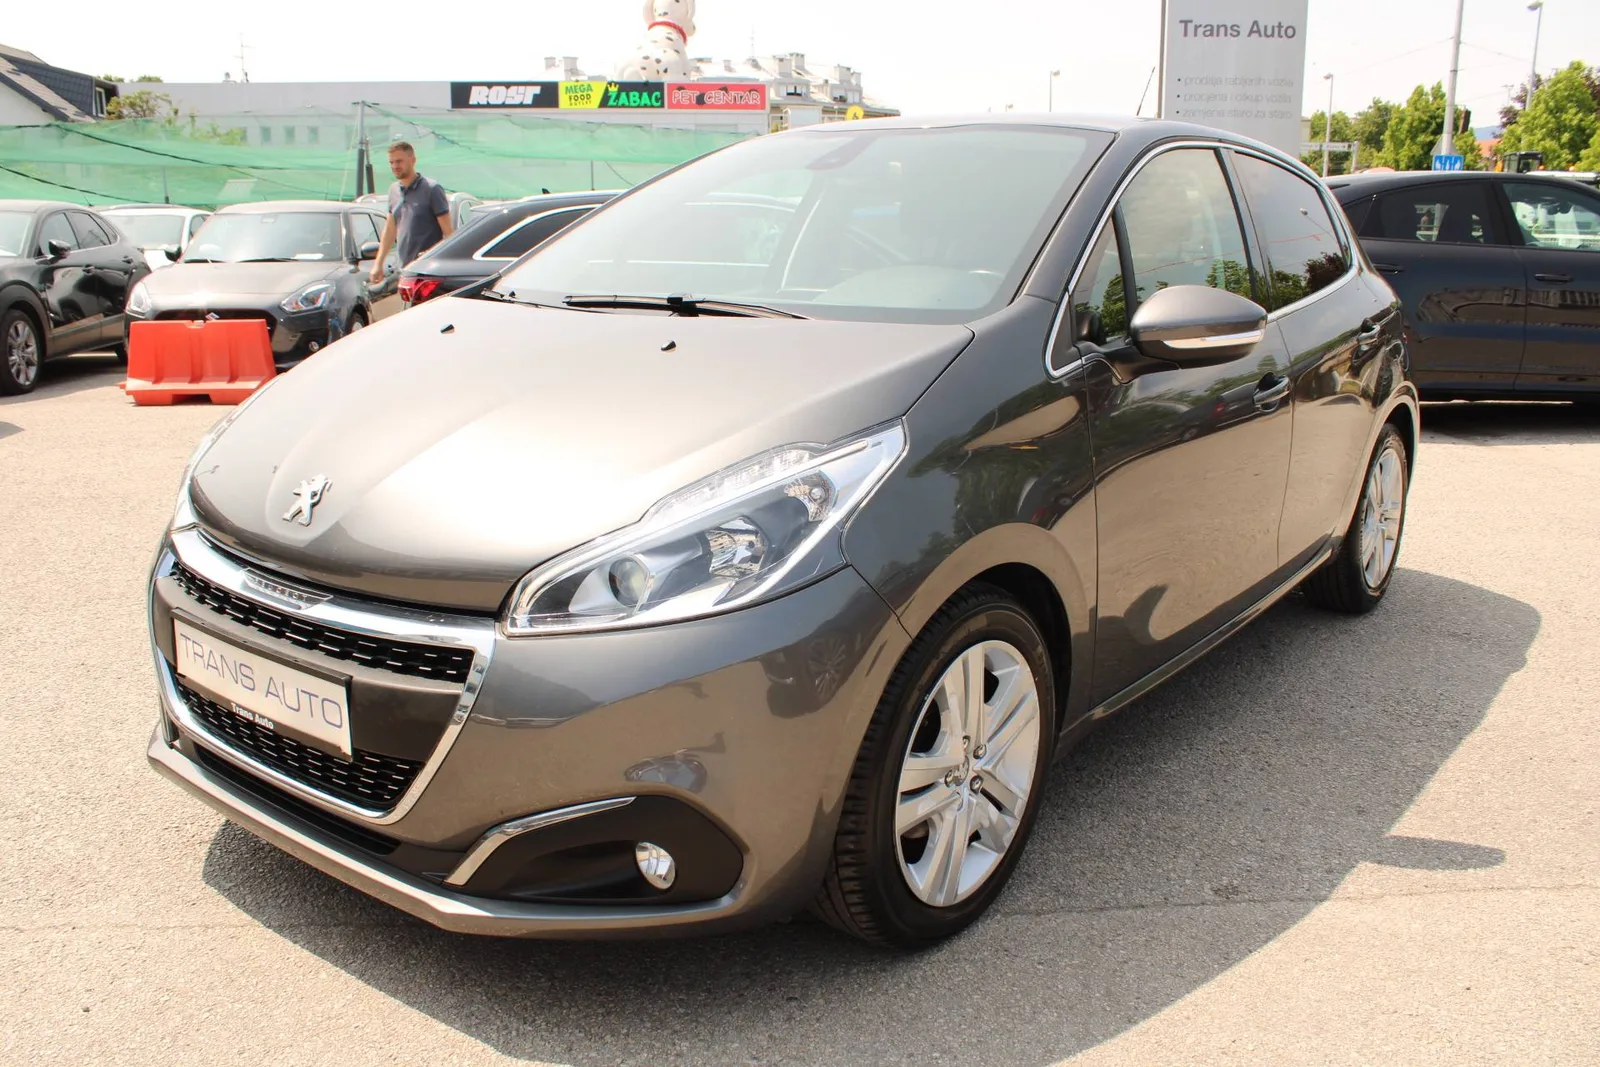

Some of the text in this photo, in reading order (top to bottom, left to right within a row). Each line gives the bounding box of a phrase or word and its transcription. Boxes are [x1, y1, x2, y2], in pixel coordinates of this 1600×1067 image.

[1179, 19, 1297, 39] Trans Auto
[468, 85, 542, 105] ROST
[564, 84, 594, 95] MEGA
[568, 93, 592, 102] FOOD
[672, 89, 761, 105] PET CENTAR
[180, 633, 343, 729] TRANS AUTO
[230, 701, 274, 730] Trans Auto
